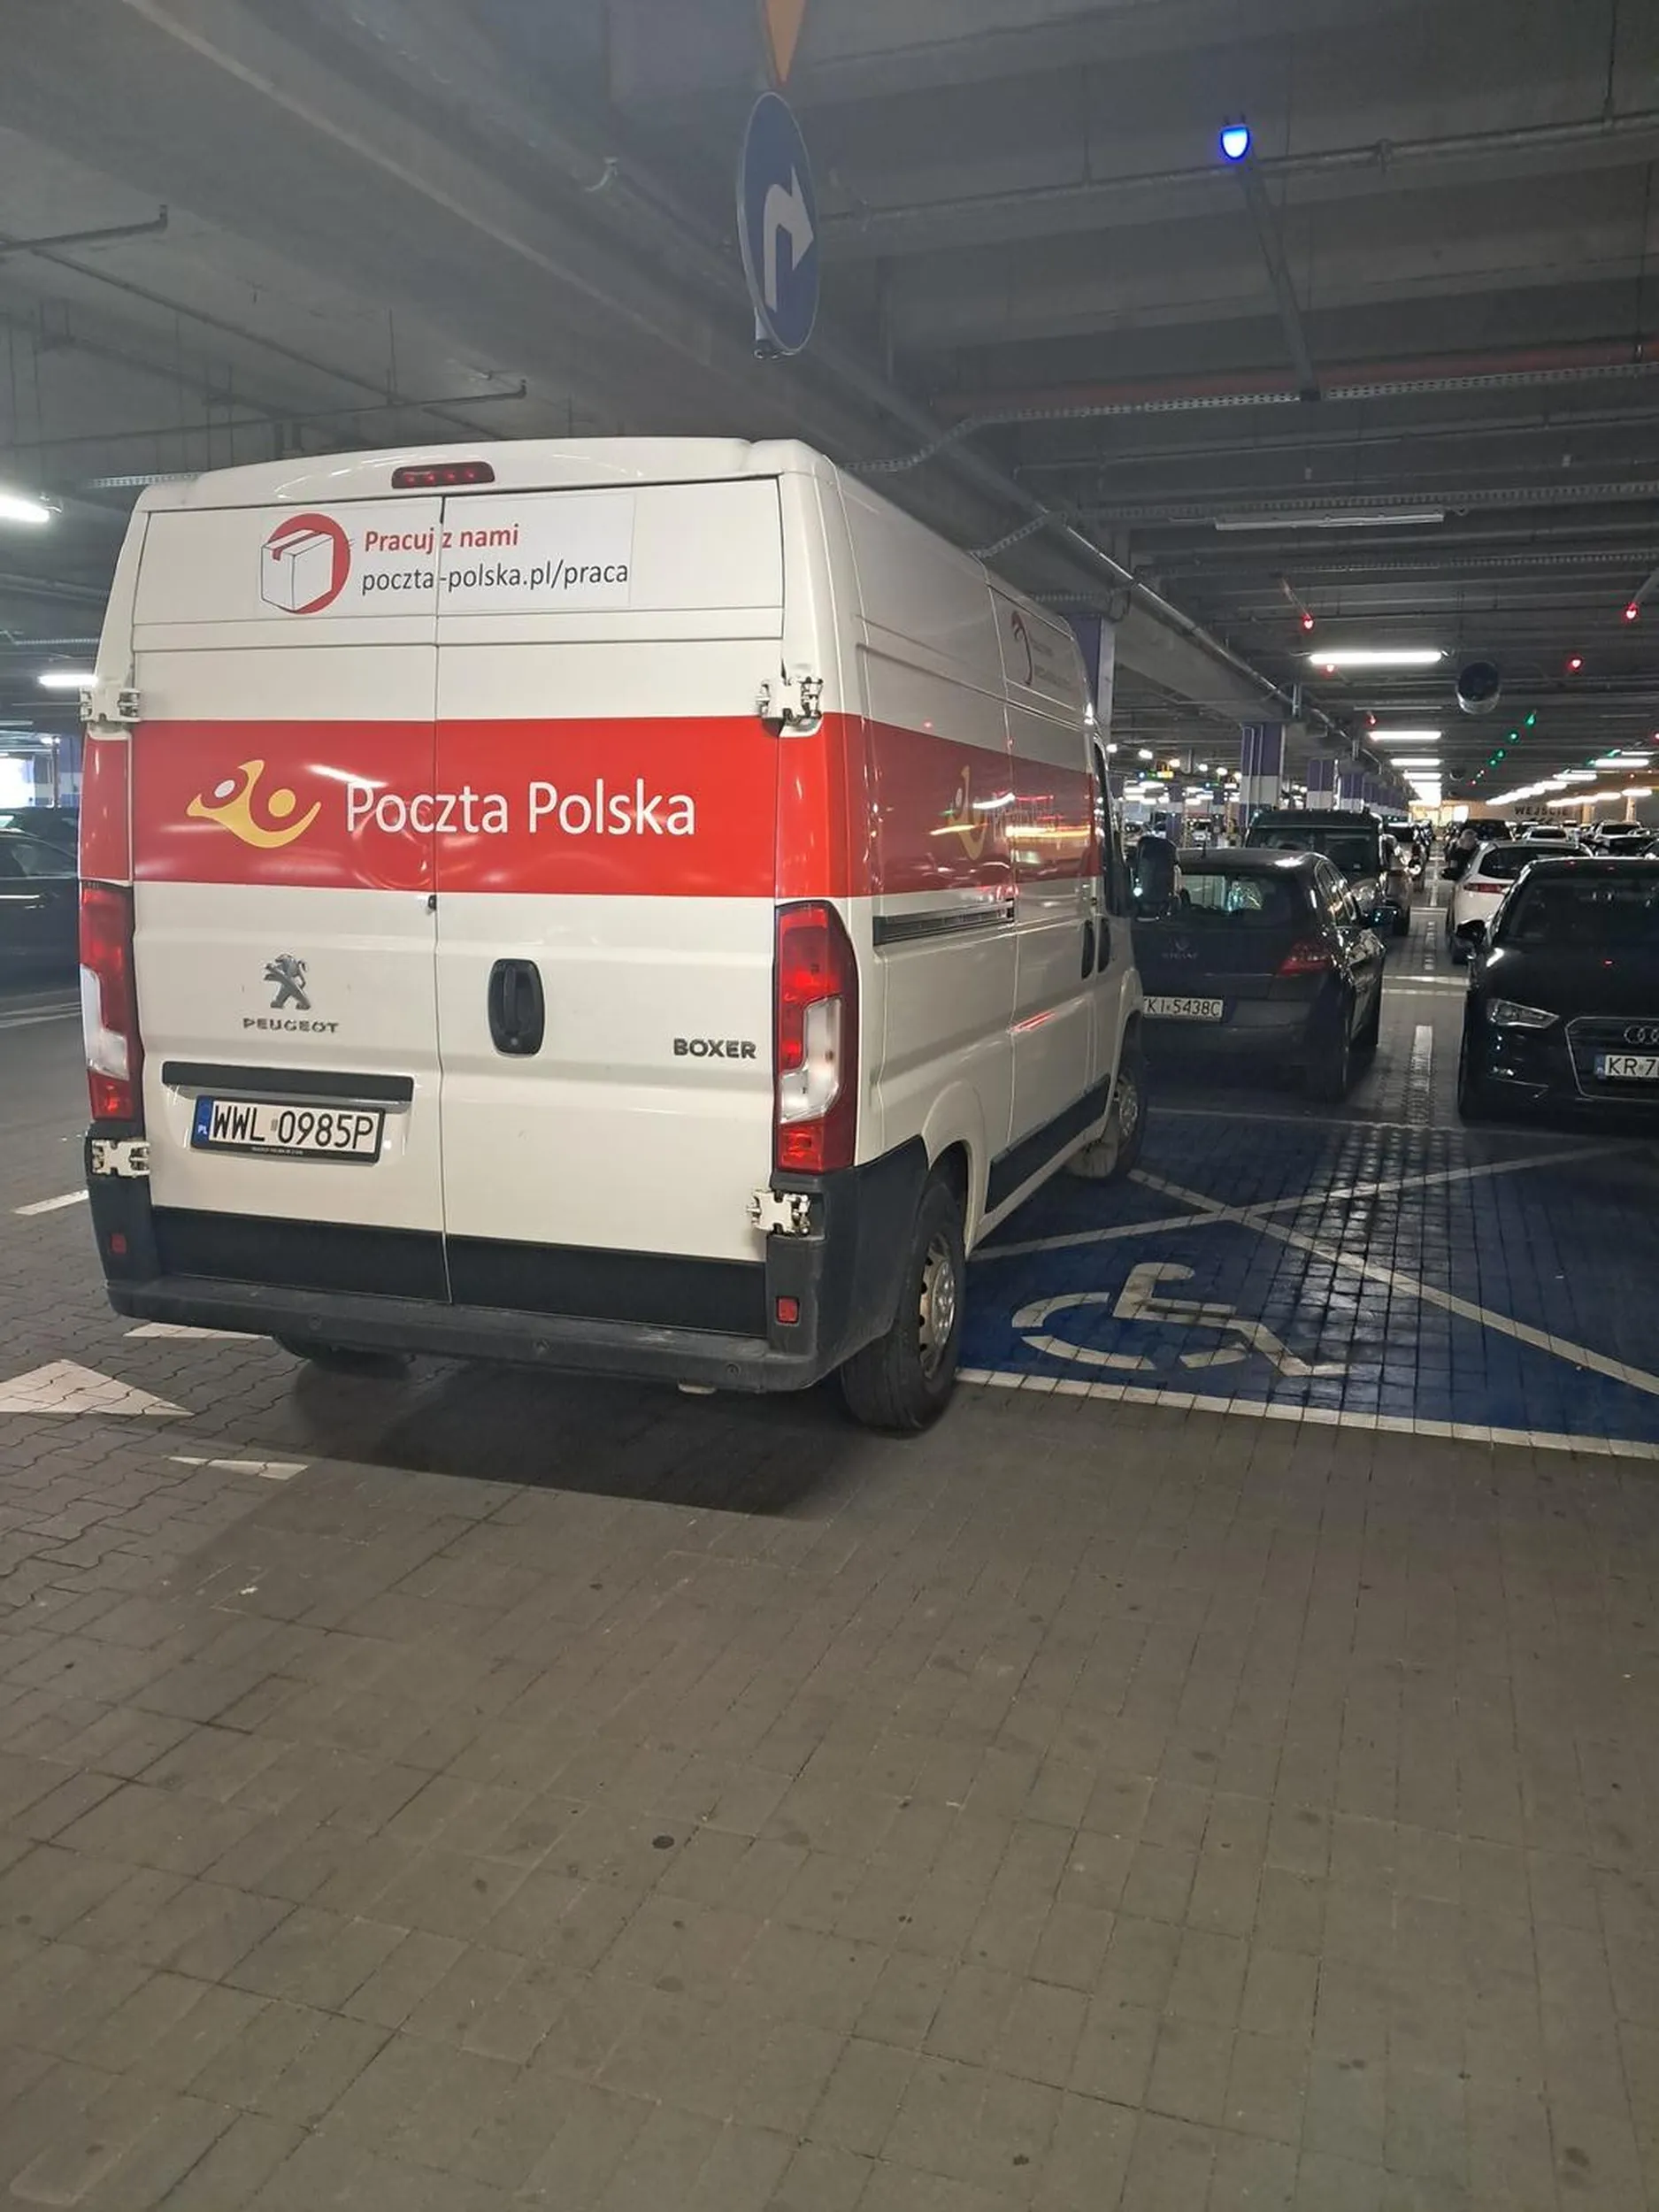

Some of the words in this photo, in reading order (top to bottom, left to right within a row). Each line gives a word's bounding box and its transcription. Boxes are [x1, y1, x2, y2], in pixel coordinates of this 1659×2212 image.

[365, 527, 434, 554] Pracuj
[442, 532, 452, 549] z
[459, 524, 519, 548] nami
[362, 560, 628, 595] poczta-polska.pl/praca
[346, 781, 509, 833] Poczta
[528, 778, 695, 835] Polska
[1143, 998, 1165, 1013] KI
[1172, 999, 1221, 1016] 5438C
[242, 1018, 339, 1033] PEUGEOT
[673, 1038, 757, 1059] BOXER
[1608, 1056, 1637, 1075] KR
[1645, 1058, 1659, 1076] 7
[197, 1125, 208, 1134] PL
[212, 1105, 265, 1141] WWL
[278, 1110, 373, 1149] 0985P
